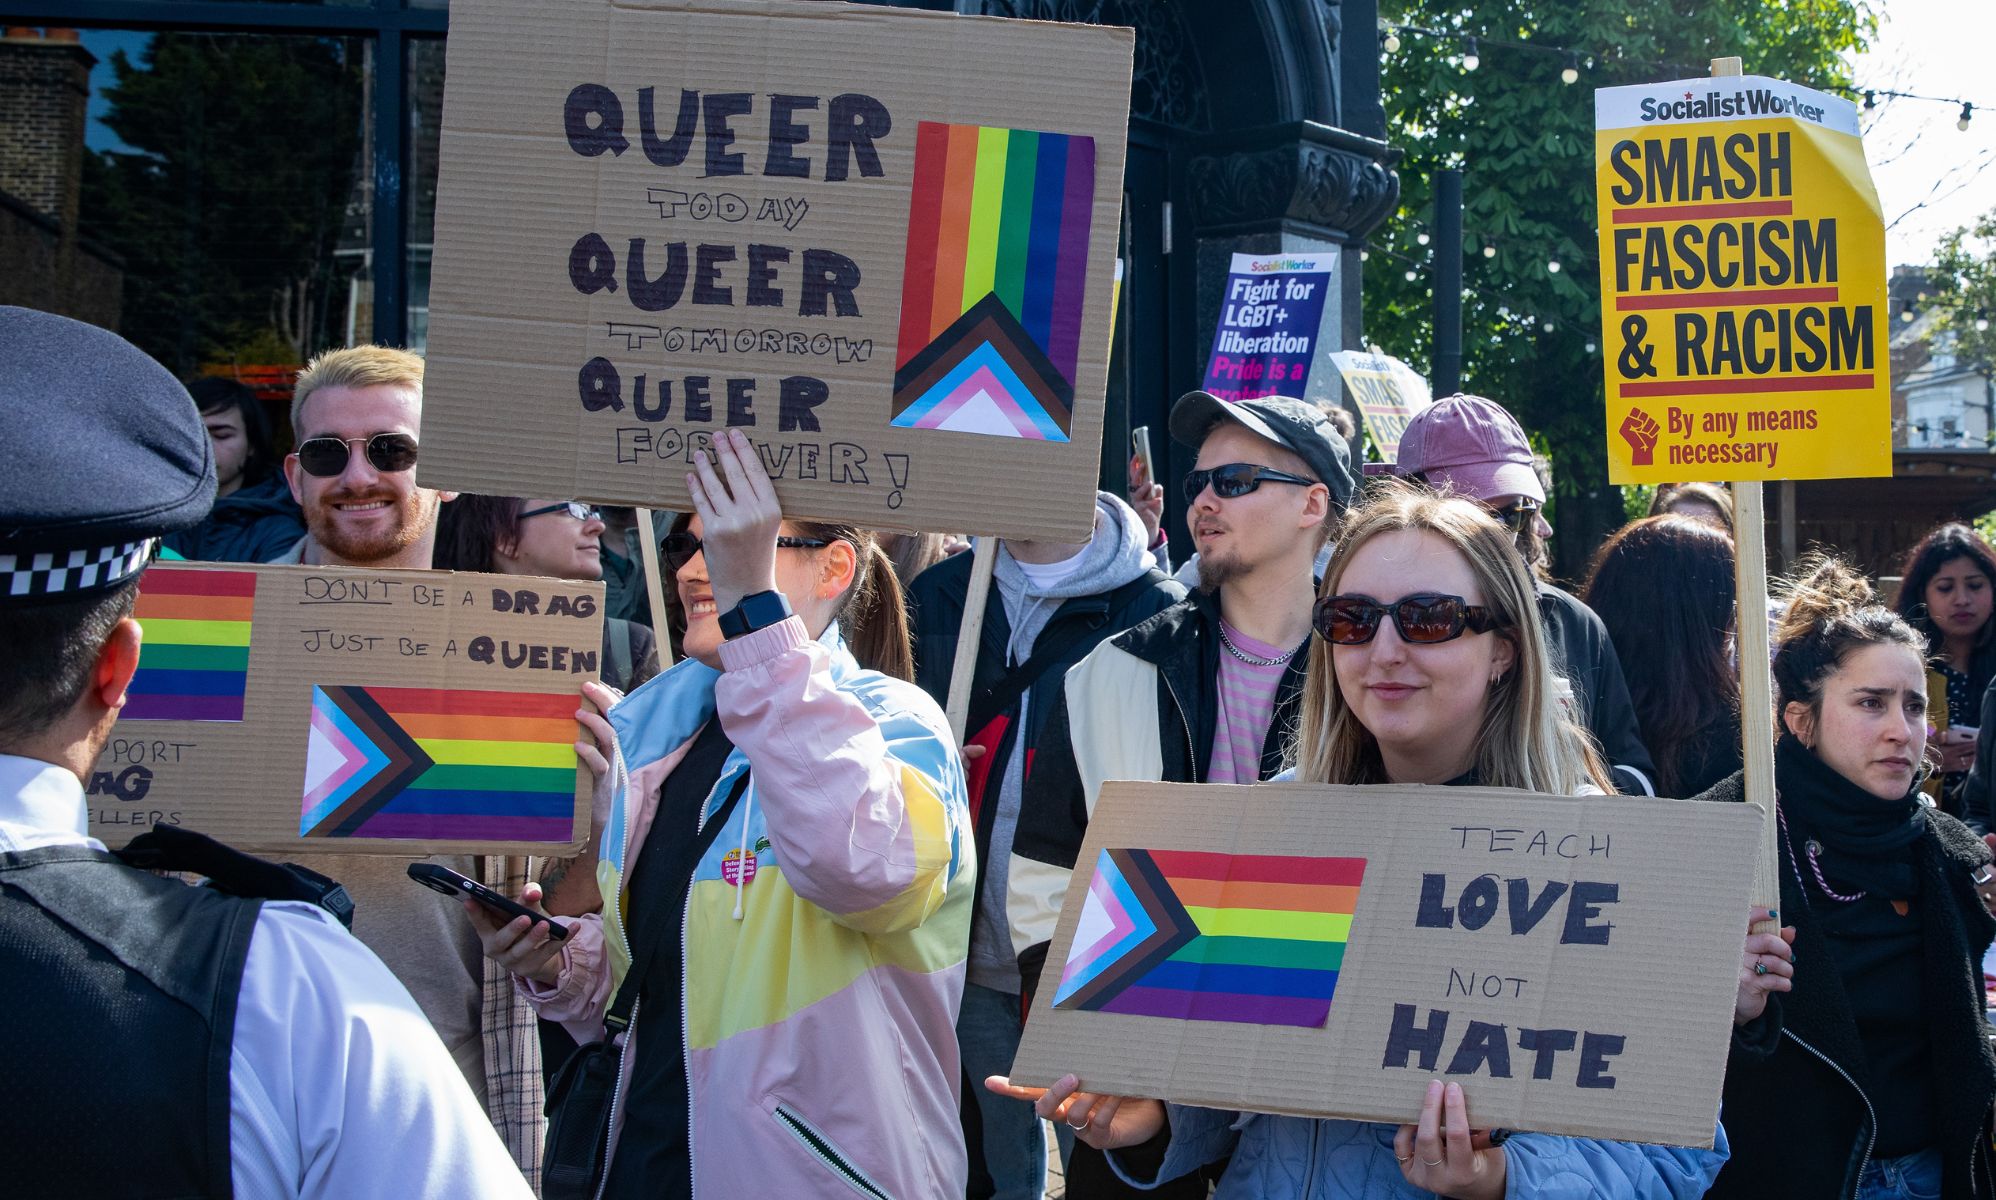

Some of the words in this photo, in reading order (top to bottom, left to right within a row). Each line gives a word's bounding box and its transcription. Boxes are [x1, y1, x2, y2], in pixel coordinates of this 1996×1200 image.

[564, 83, 893, 182] QUEER
[1610, 132, 1793, 206] SMASH
[647, 187, 810, 232] TODAY
[568, 232, 863, 318] QUEER
[1613, 218, 1838, 293] FASCISM
[1230, 278, 1280, 305] Fight
[1285, 278, 1315, 300] for
[1224, 304, 1289, 328] LGBT+
[606, 322, 873, 364] TOMORROW
[1217, 330, 1310, 354] liberation
[1617, 314, 1658, 380] &
[1674, 305, 1875, 377] RACISM
[1211, 355, 1264, 380] Pride
[1268, 357, 1286, 380] is
[1290, 362, 1305, 381] a
[578, 356, 830, 432] QUEER
[1351, 376, 1405, 407] SMAS
[1667, 406, 1694, 440] By
[1702, 411, 1739, 438] any
[1747, 409, 1818, 432] means
[617, 428, 909, 509] FORVER!
[1669, 442, 1779, 469] necessary
[303, 576, 402, 600] DON'T
[413, 586, 445, 606] BE
[462, 585, 474, 606] A
[491, 588, 597, 618] DRAG
[300, 630, 384, 653] JUST
[399, 637, 429, 657] BE
[442, 640, 458, 658] A
[468, 636, 597, 674] QUEEN
[104, 739, 197, 764] PORT
[1451, 826, 1611, 858] TEACH
[1415, 872, 1620, 945] LOVE
[1446, 968, 1528, 998] NOT
[1382, 1003, 1627, 1090] HATE
